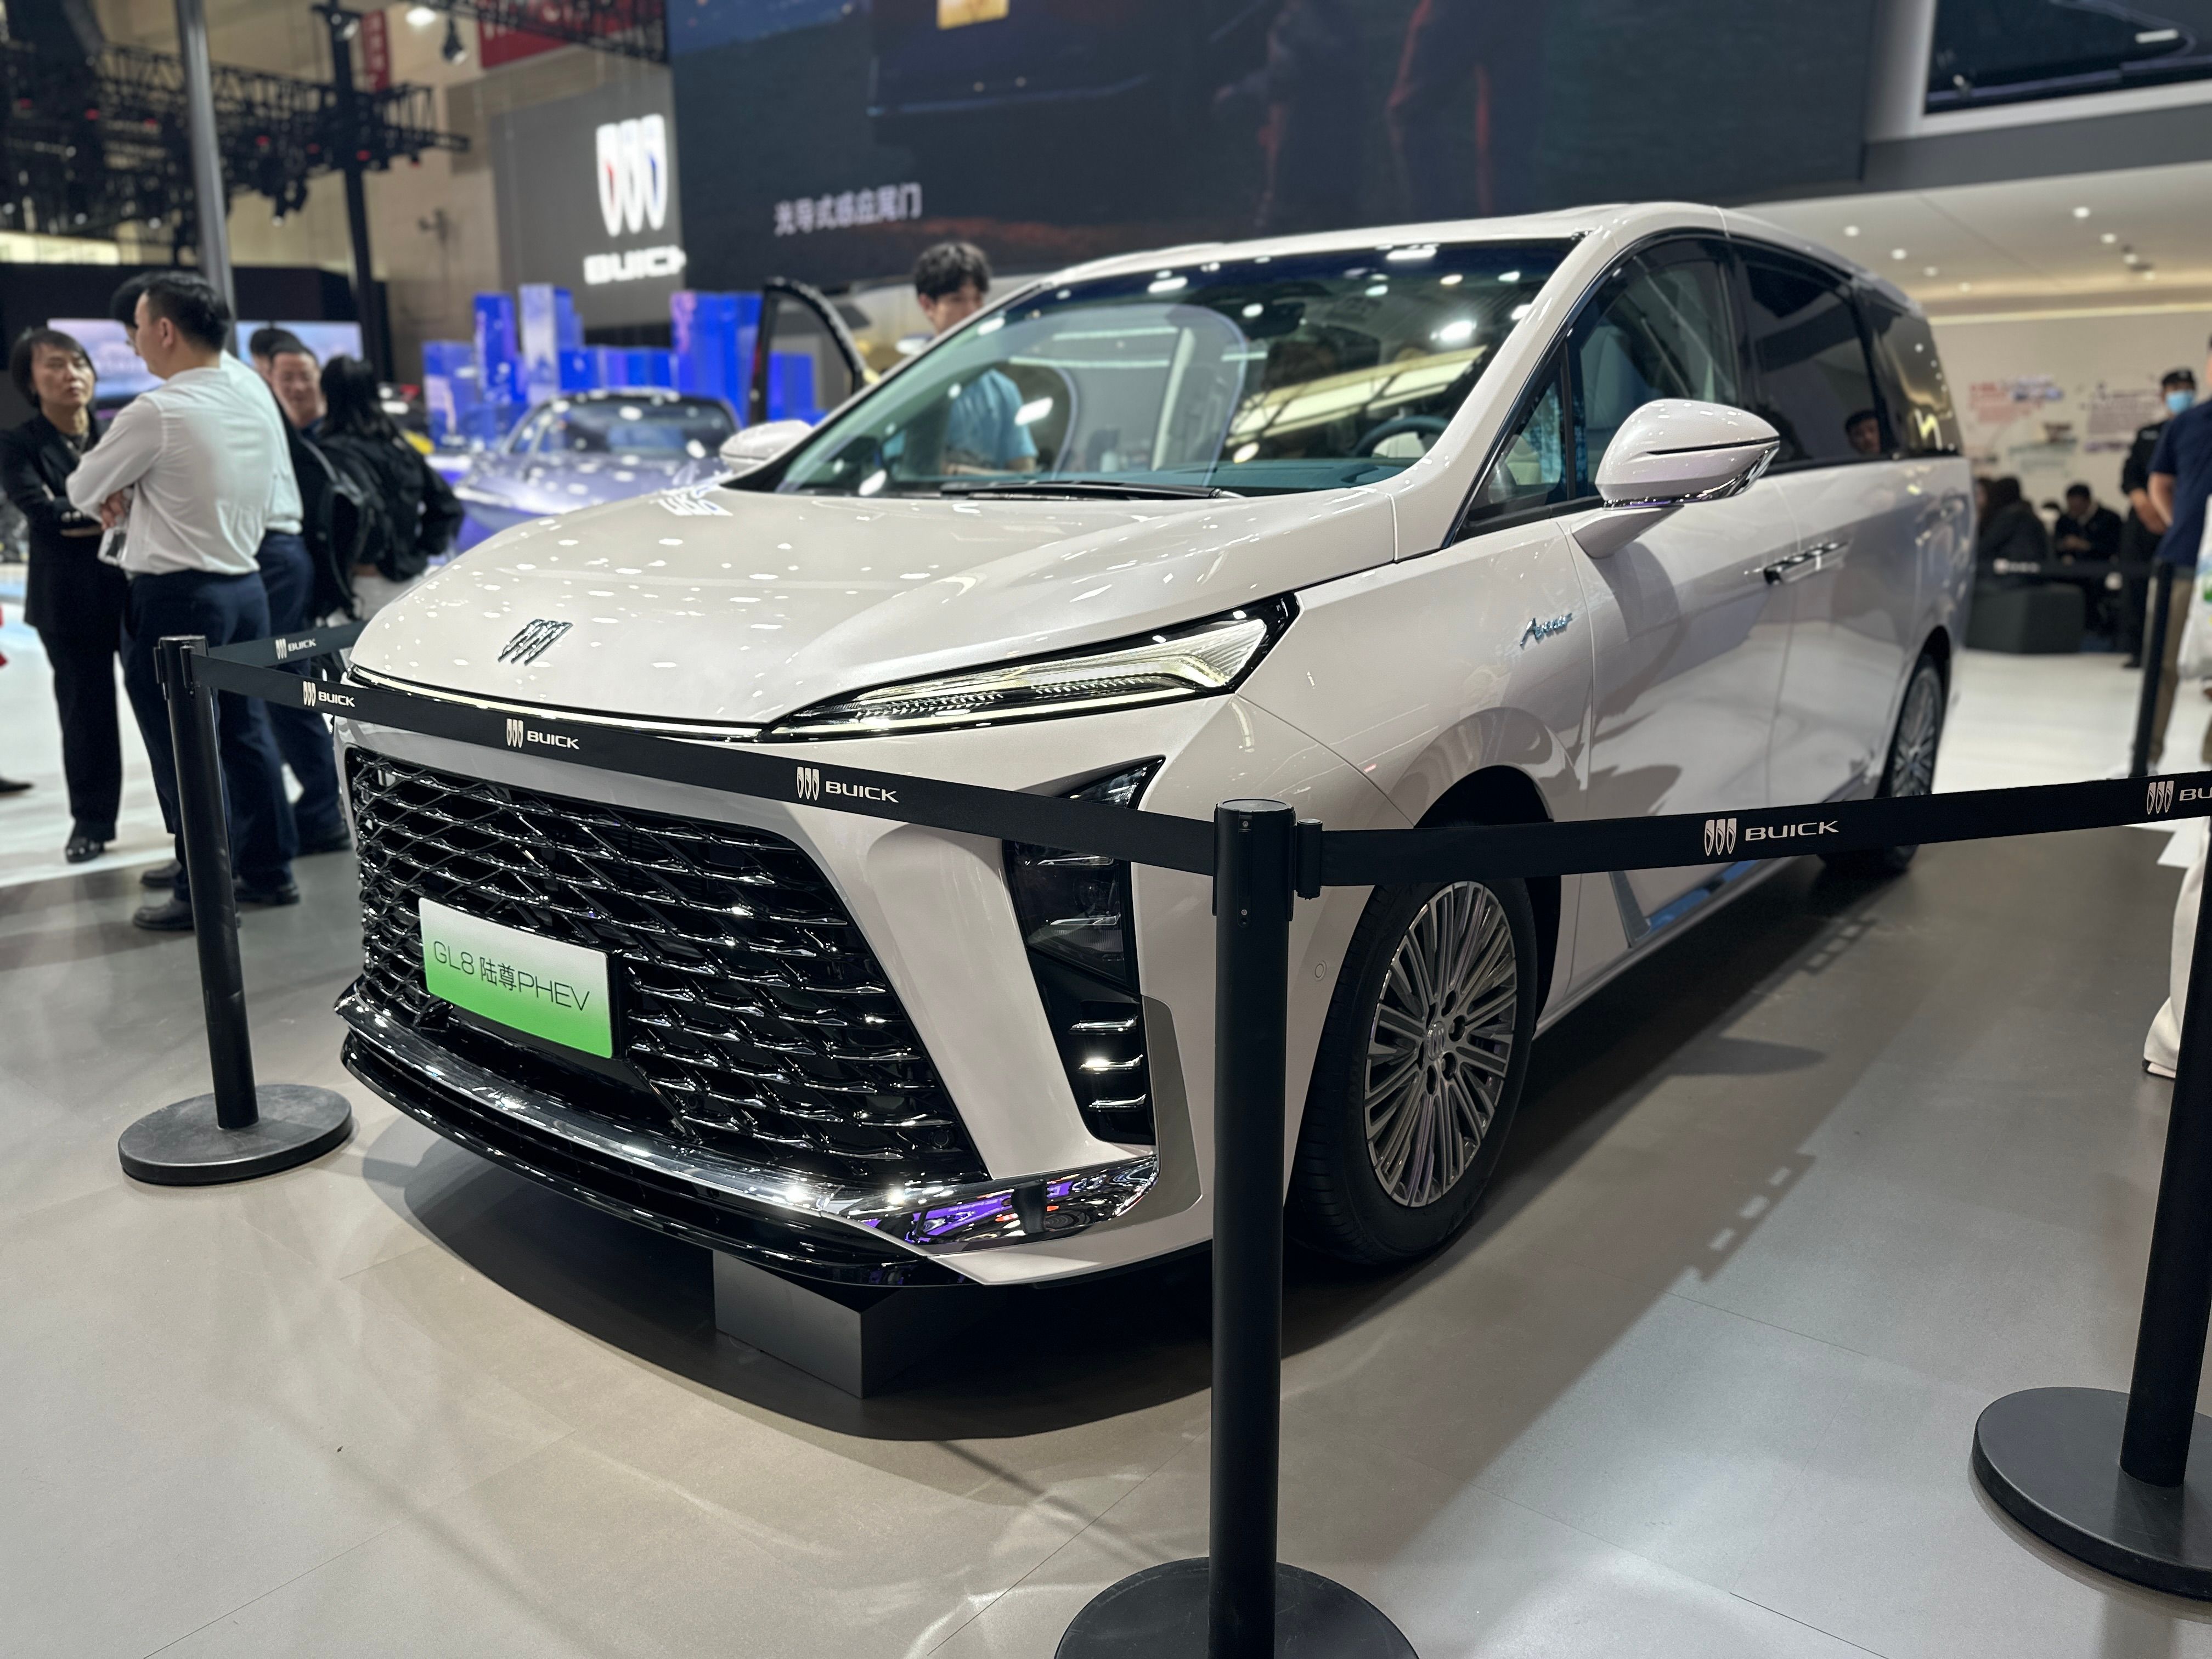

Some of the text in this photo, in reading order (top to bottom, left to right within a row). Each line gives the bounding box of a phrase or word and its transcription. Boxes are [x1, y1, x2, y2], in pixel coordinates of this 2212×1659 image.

[288, 638, 316, 652] BUICK
[318, 690, 355, 708] BUICK
[527, 730, 580, 750] BUICK
[826, 781, 899, 803] BUICK
[1745, 820, 1839, 841] BUICK
[433, 940, 475, 975] GL8
